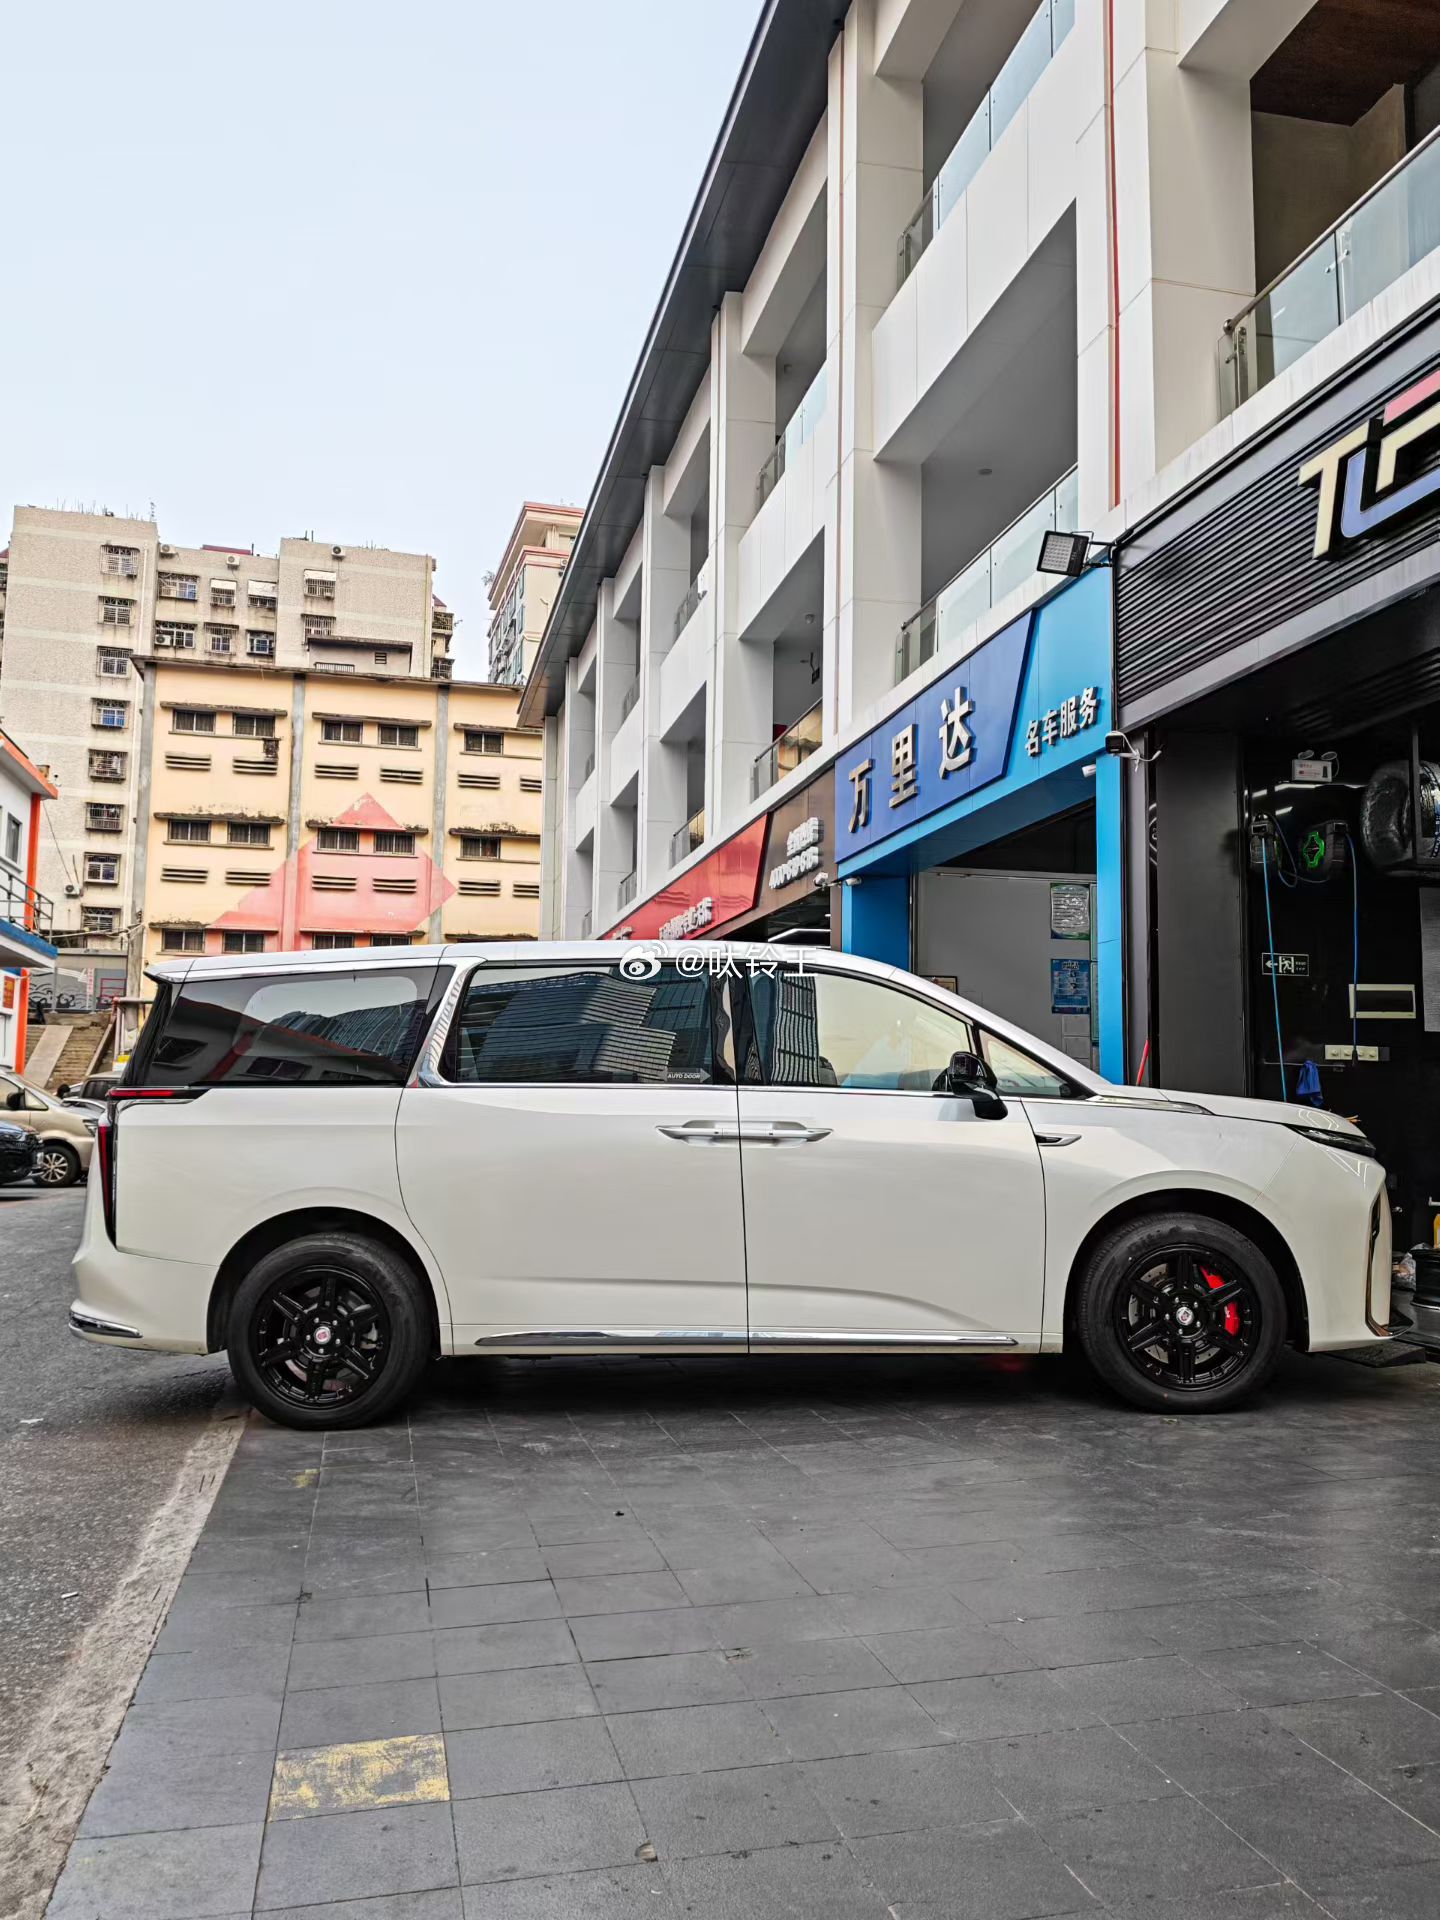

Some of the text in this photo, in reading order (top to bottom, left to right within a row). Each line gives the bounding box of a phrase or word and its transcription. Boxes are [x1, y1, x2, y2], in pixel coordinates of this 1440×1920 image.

[849, 686, 975, 833] 万里达
[1025, 687, 1099, 756] 名车服务
